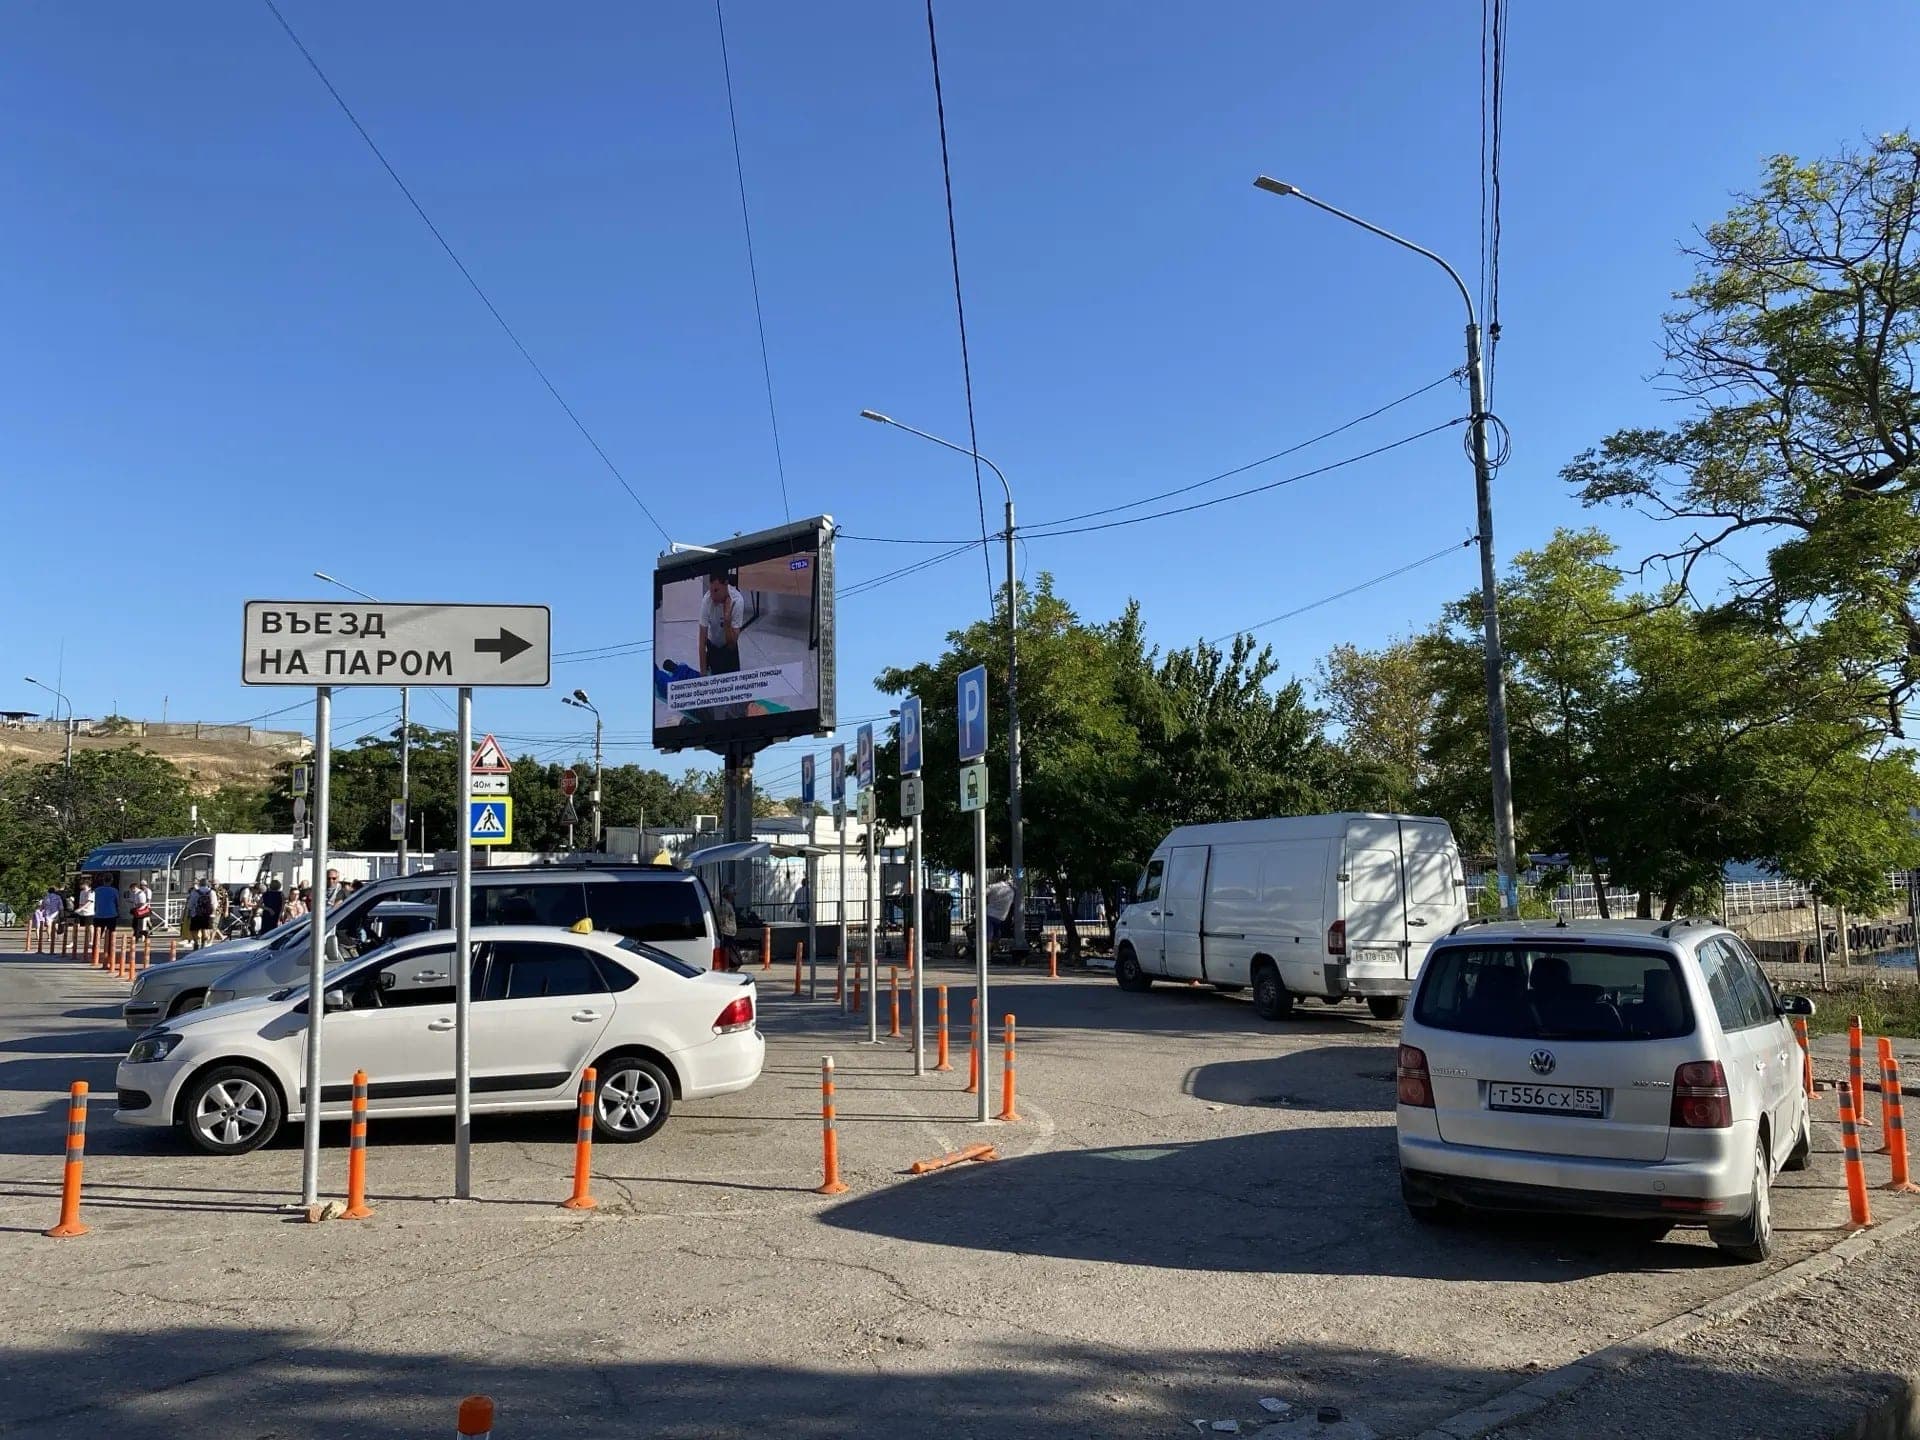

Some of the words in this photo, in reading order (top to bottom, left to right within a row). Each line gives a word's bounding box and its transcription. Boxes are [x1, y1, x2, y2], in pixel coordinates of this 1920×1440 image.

[262, 612, 386, 639] ВЪЕЗД
[260, 649, 309, 675] НА
[325, 650, 453, 676] ПАРОМ
[710, 675, 738, 686] обучаются
[738, 672, 758, 683] первой
[759, 669, 782, 680] помощи
[674, 692, 692, 700] рамках
[693, 685, 733, 698] общегородской
[734, 680, 768, 691] инициативы
[696, 695, 730, 706] Севастополь
[966, 679, 980, 749] P
[904, 708, 916, 765] P
[473, 780, 490, 788] 40м
[101, 852, 173, 866] АВТОСТАНЦ
[1499, 1087, 1570, 1107] Т556СХ
[1576, 1090, 1594, 1104] 55
